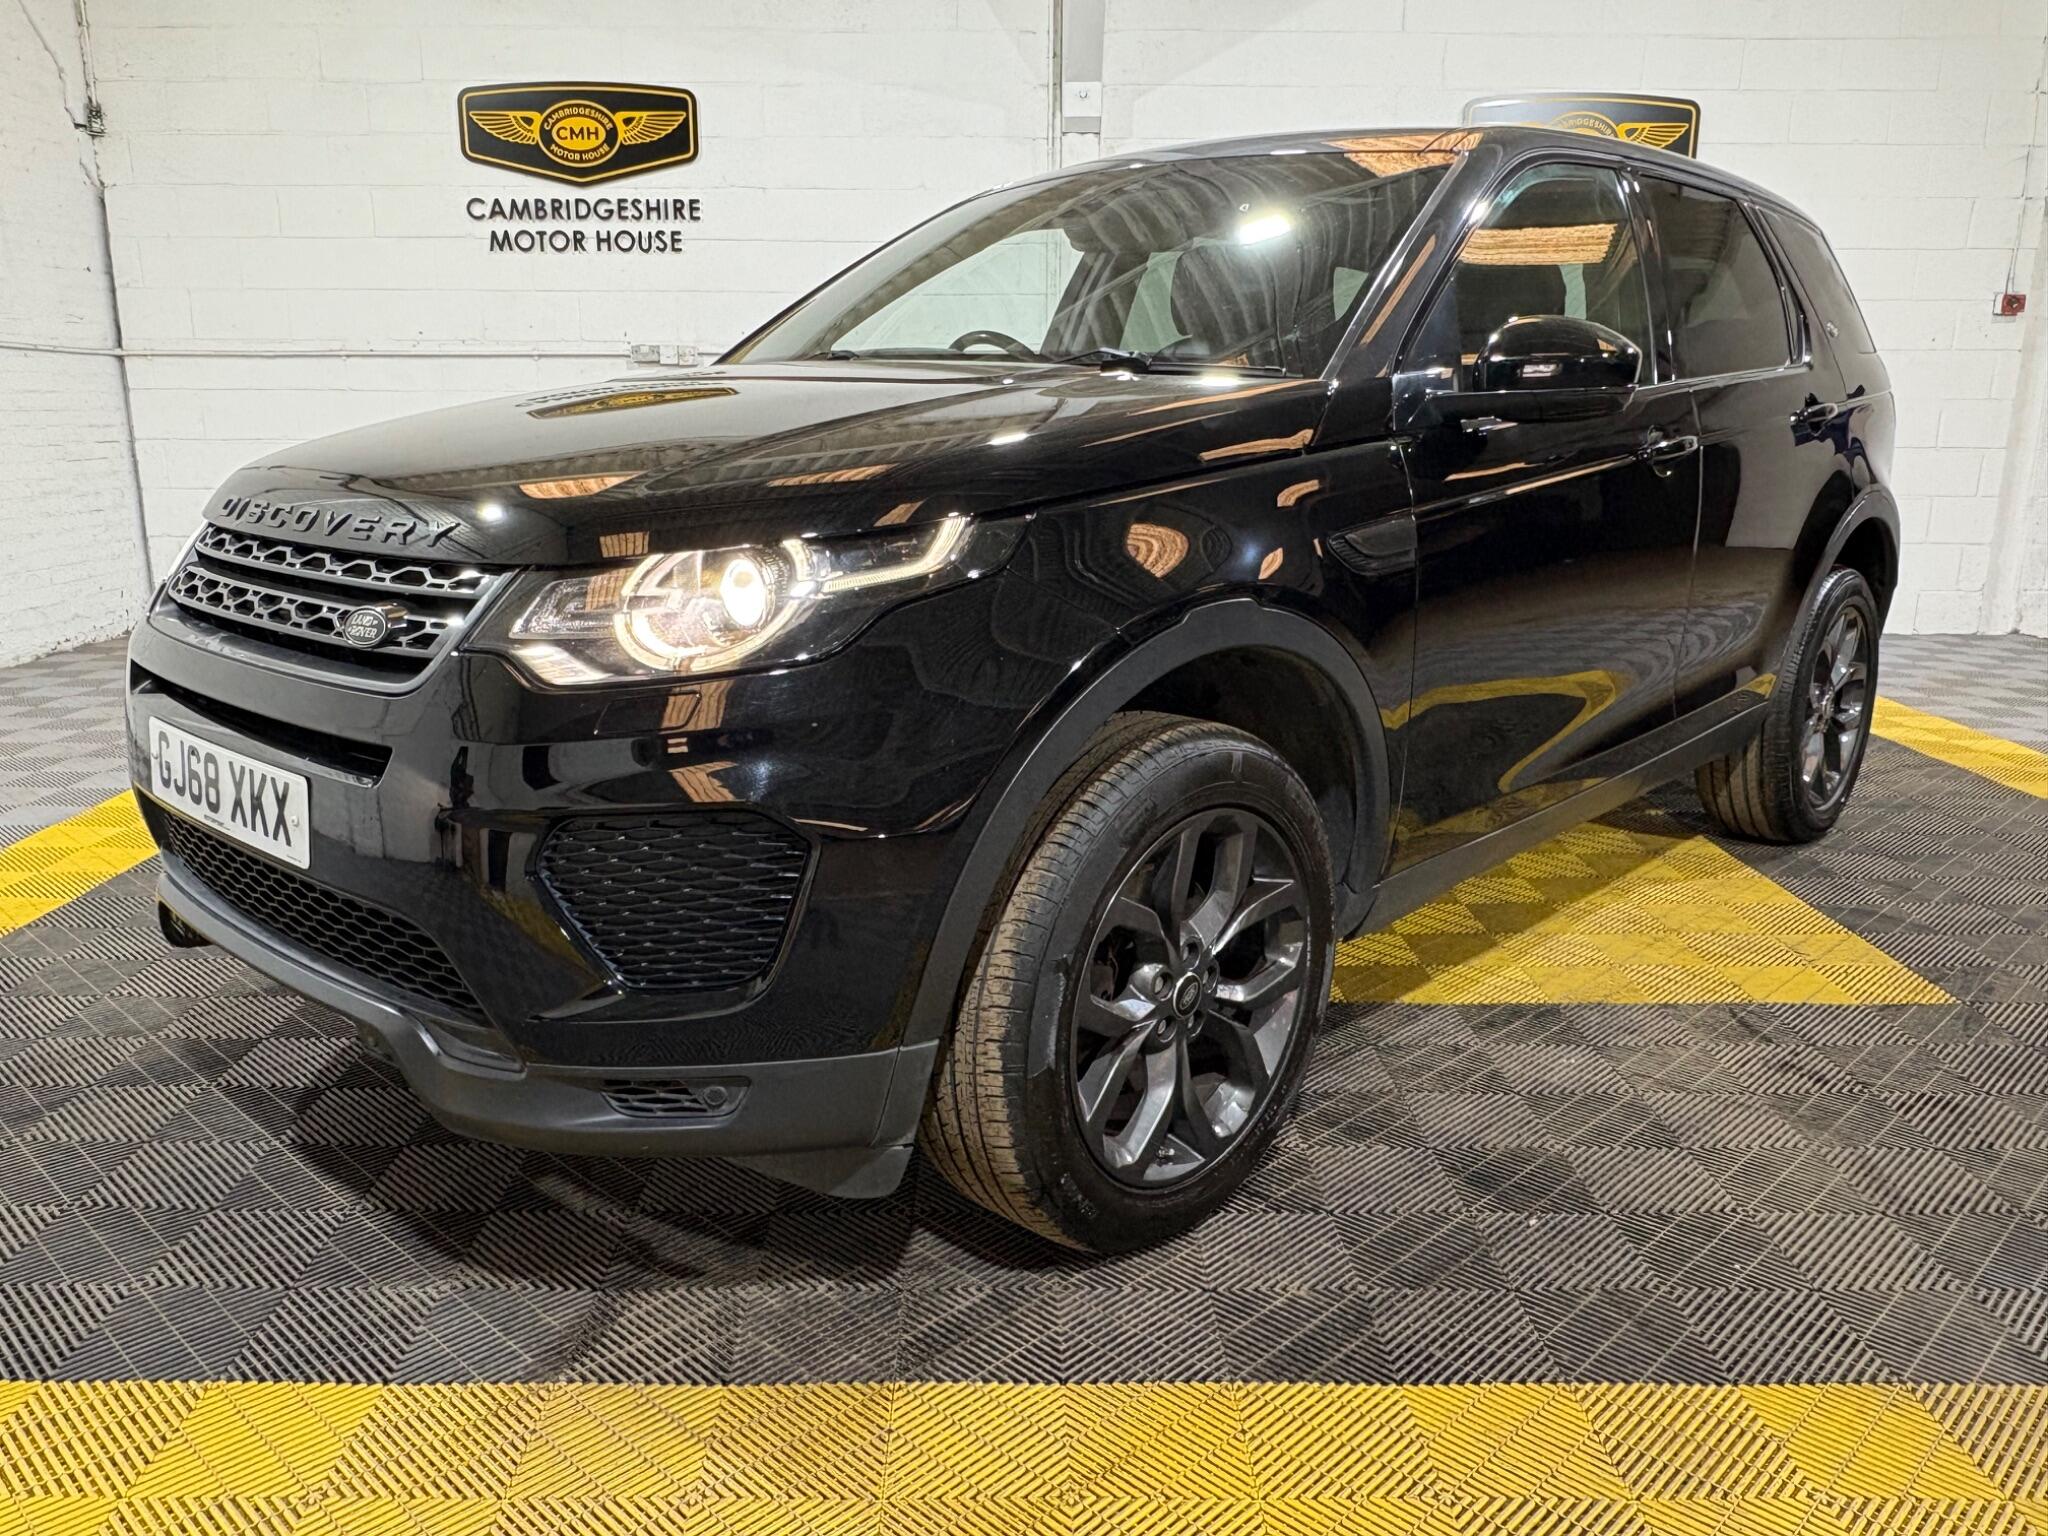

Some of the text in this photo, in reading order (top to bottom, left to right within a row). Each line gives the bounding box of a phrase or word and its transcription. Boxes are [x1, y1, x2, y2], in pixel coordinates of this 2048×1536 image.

[544, 107, 614, 130] CAMBRIDGESHIRE
[556, 126, 600, 141] CMH
[550, 142, 610, 160] MOTOR HOUSE
[466, 197, 702, 221] CAMBRIDGESHIRE
[489, 229, 683, 253] MOTOR HOUSE
[219, 497, 462, 548] DISCOVERY
[158, 730, 292, 848] GJ68 XKX
